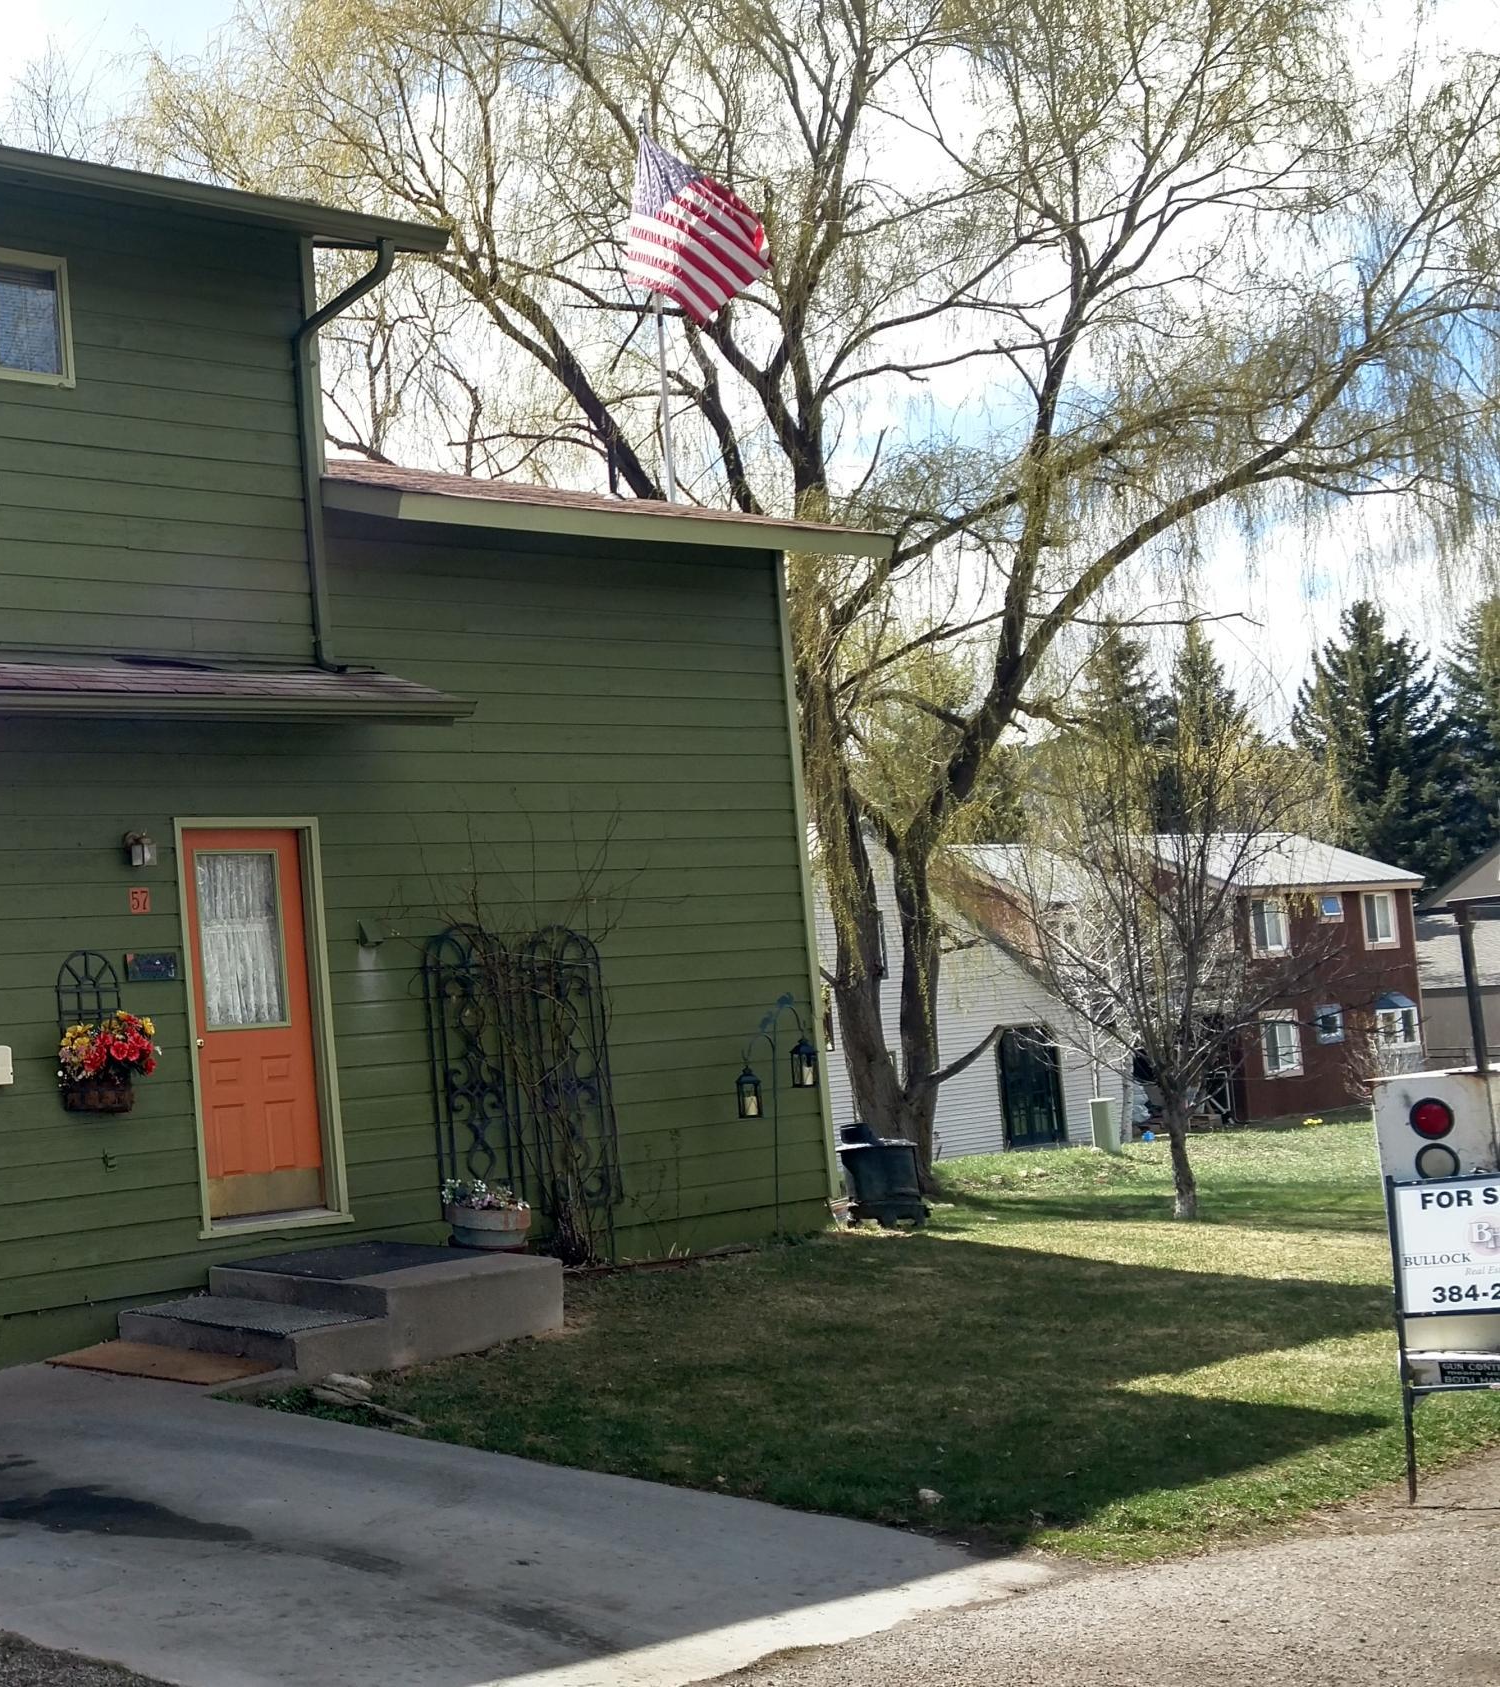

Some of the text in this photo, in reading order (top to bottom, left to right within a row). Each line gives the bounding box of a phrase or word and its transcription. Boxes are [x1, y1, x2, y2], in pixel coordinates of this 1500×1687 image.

[131, 890, 149, 910] 57
[1421, 1189, 1474, 1210] FOR
[1403, 1253, 1472, 1267] BULLOCK
[1465, 1266, 1486, 1276] Real
[1432, 1283, 1500, 1303] 384-2
[1444, 1376, 1476, 1384] BOTH
